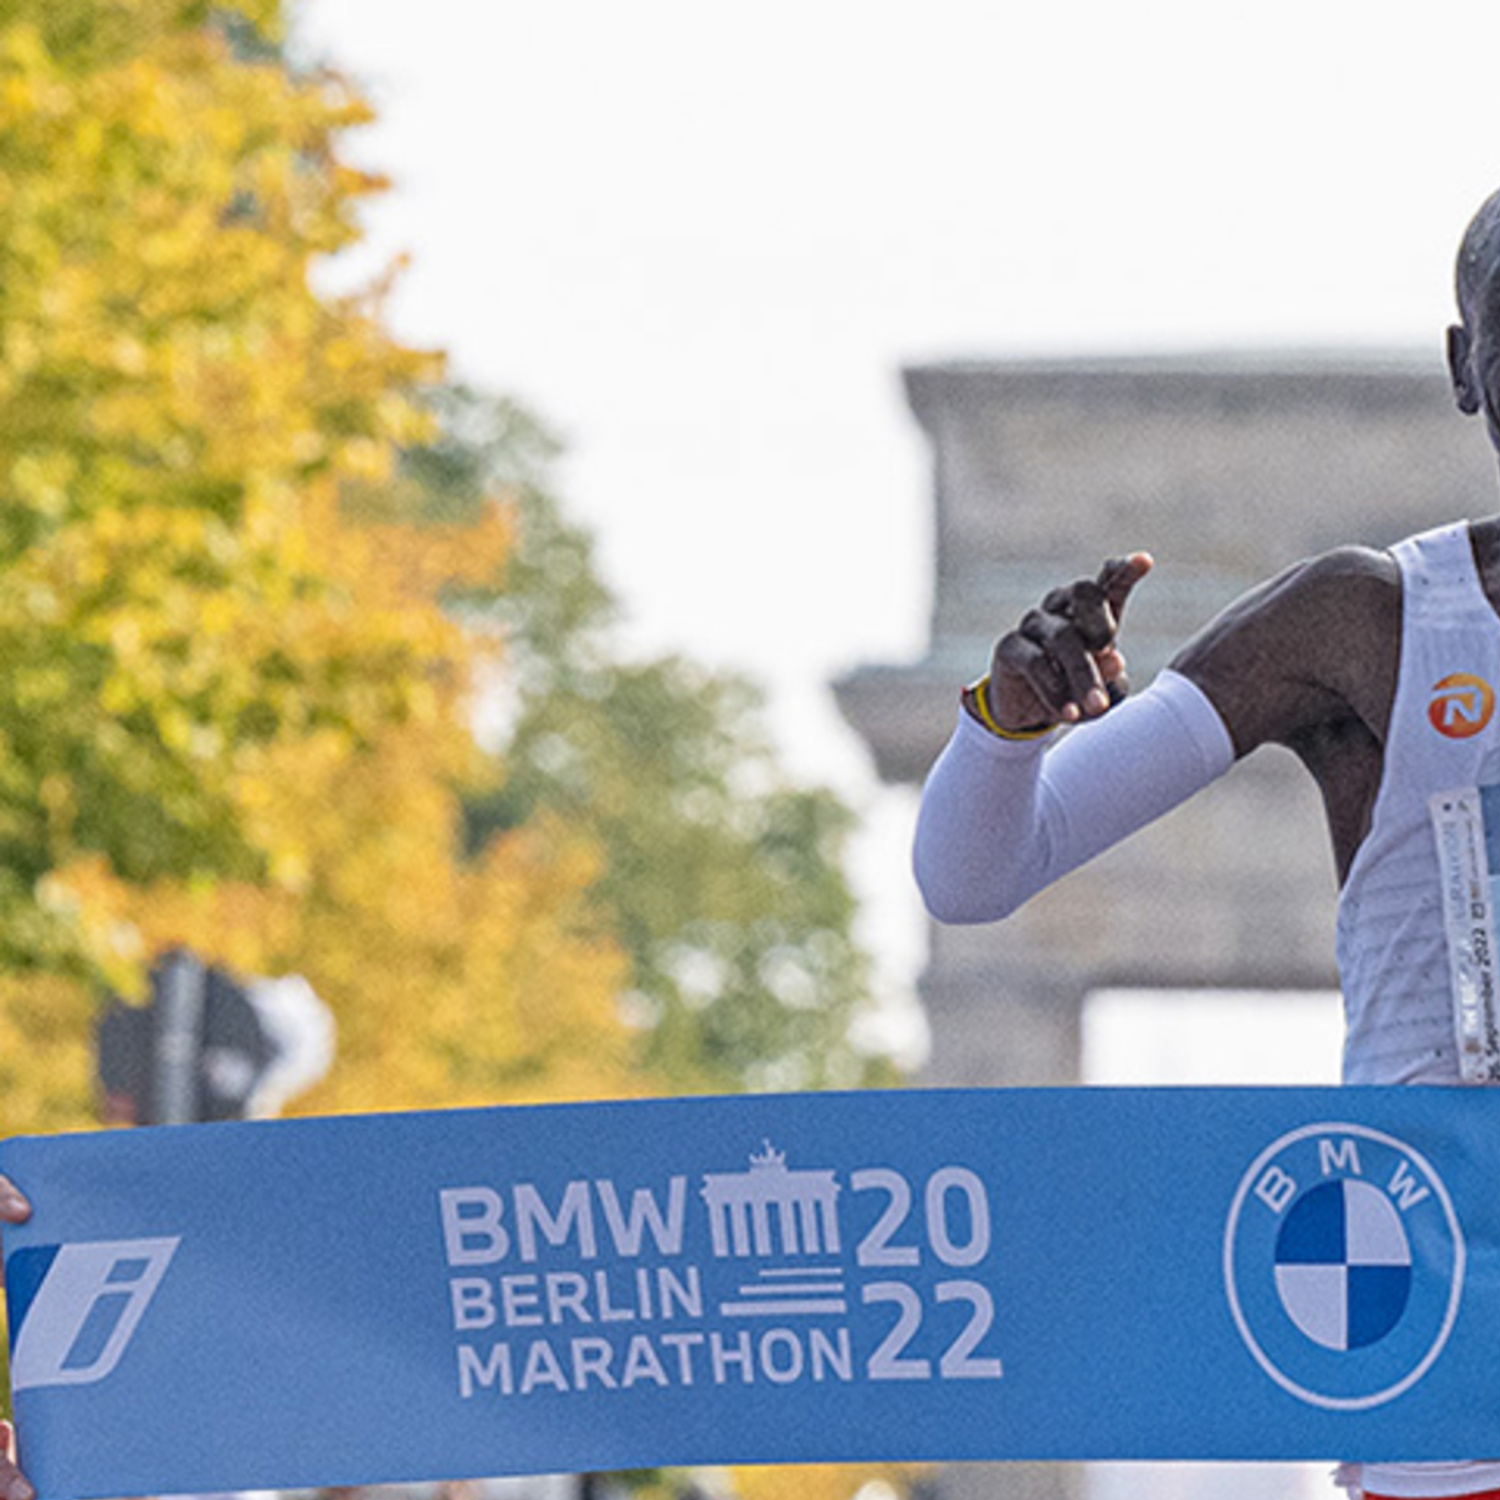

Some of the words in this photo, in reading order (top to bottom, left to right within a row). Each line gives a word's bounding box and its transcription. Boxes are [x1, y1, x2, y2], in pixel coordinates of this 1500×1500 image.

[851, 1167, 991, 1267] 20
[1255, 1139, 1431, 1213] BMW
[440, 1175, 686, 1267] BMW
[450, 1266, 703, 1330] BERLIN
[862, 1281, 1003, 1379] 22
[455, 1328, 853, 1398] MARATHON
